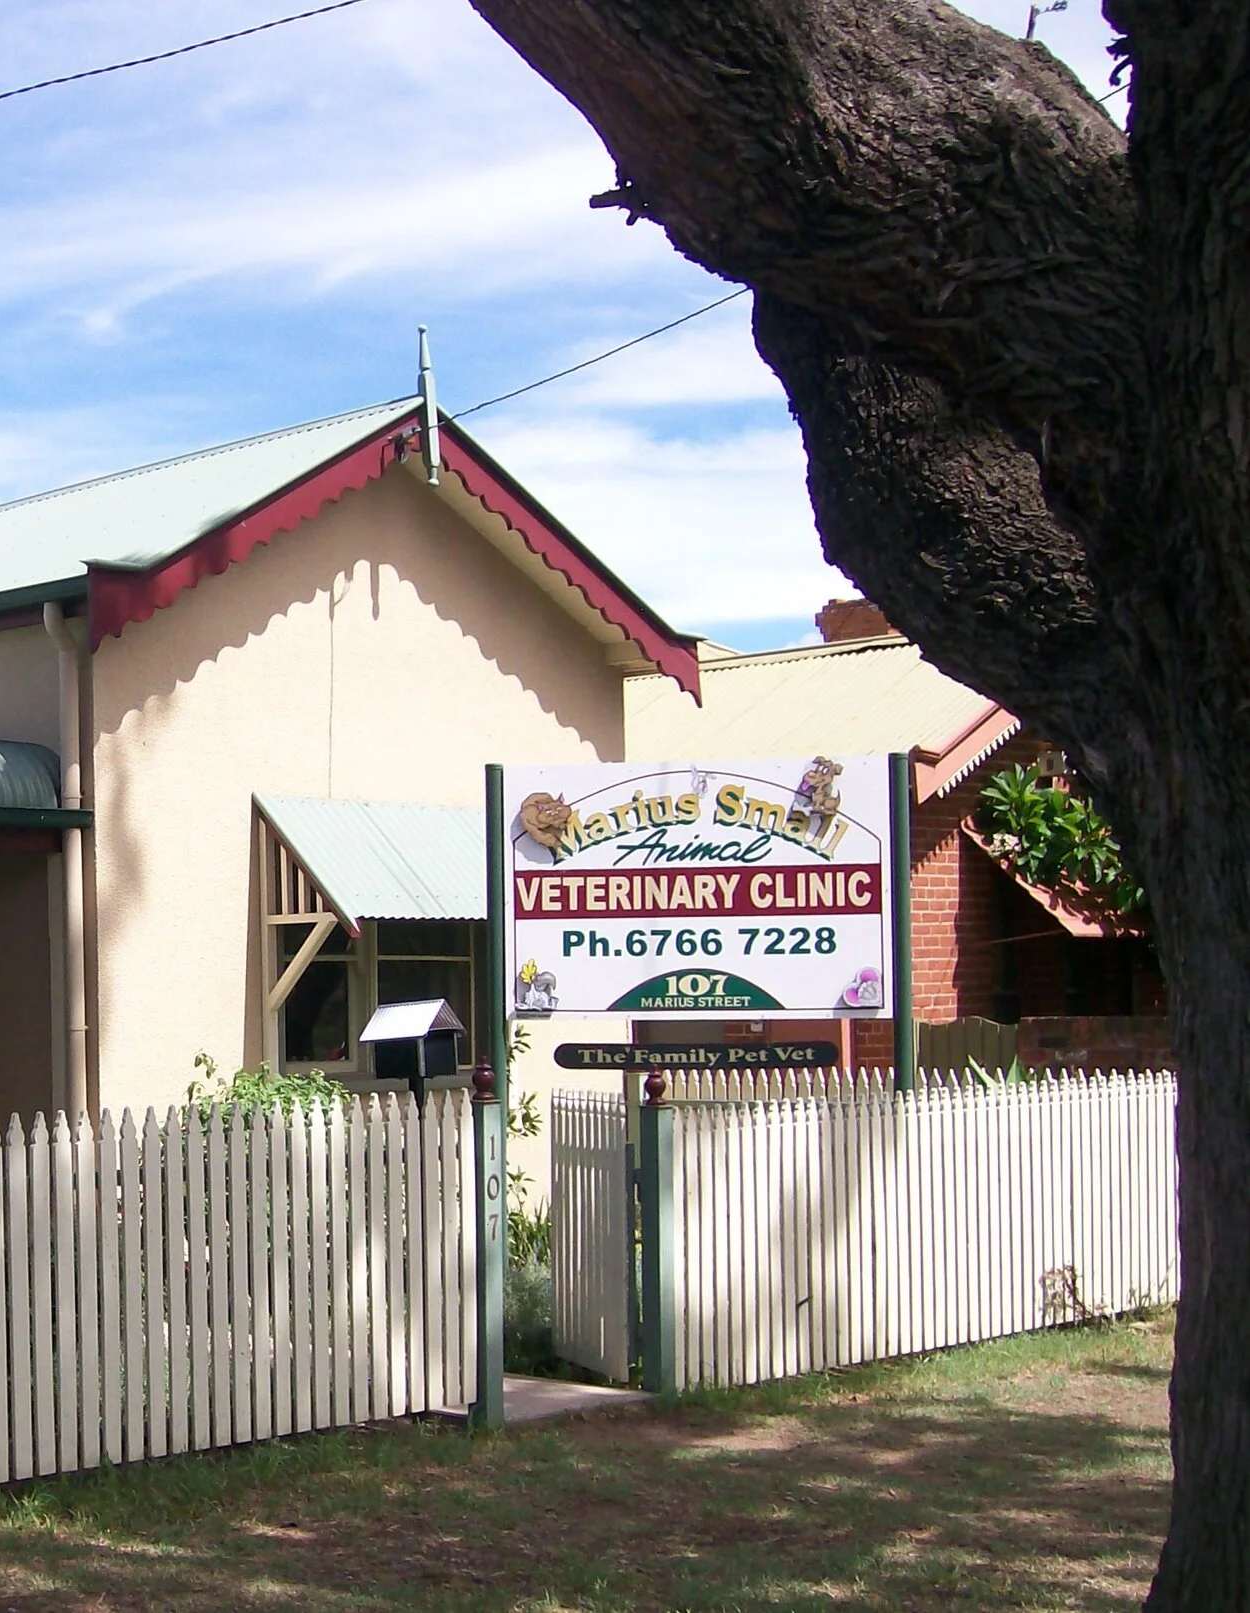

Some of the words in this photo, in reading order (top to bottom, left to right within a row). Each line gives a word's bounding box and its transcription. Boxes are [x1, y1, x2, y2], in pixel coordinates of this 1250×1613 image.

[554, 789, 702, 865] Marius
[714, 784, 848, 861] Small
[613, 829, 771, 866] Animal
[516, 873, 741, 911] VETERINARY
[749, 871, 872, 910] CLINIC
[738, 927, 837, 955] 7228
[665, 975, 727, 997] 107
[641, 997, 695, 1008] MARIUS
[698, 996, 751, 1007] STREET
[577, 1049, 625, 1064] The
[634, 1048, 720, 1067] Family
[728, 1047, 768, 1063] Pet
[775, 1046, 815, 1061] Vet
